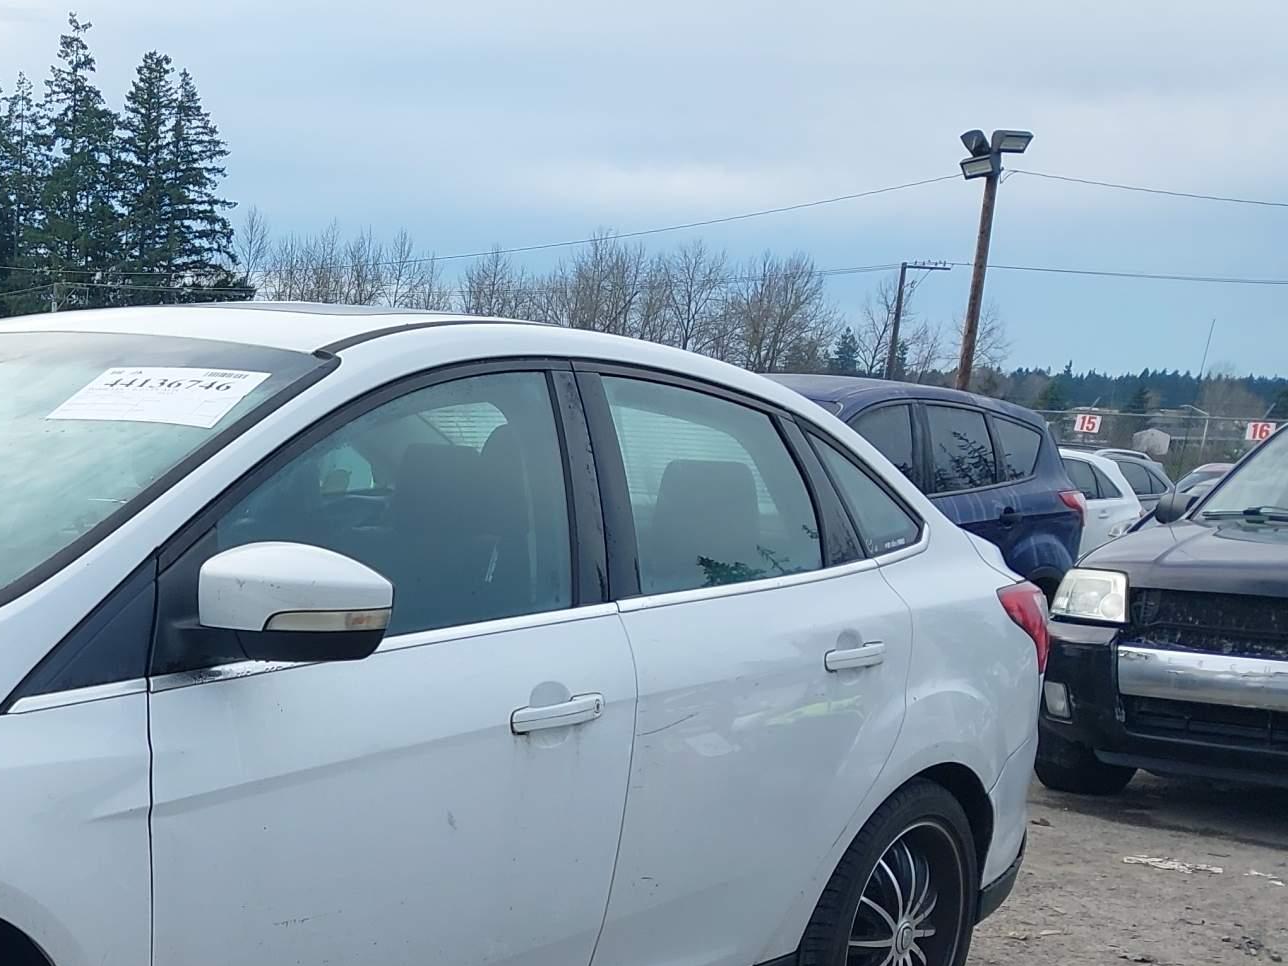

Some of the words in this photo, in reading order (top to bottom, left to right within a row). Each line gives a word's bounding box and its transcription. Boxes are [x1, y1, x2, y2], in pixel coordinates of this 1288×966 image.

[104, 377, 232, 391] 44136746
[1079, 415, 1097, 431] 15
[1252, 424, 1270, 439] 16
